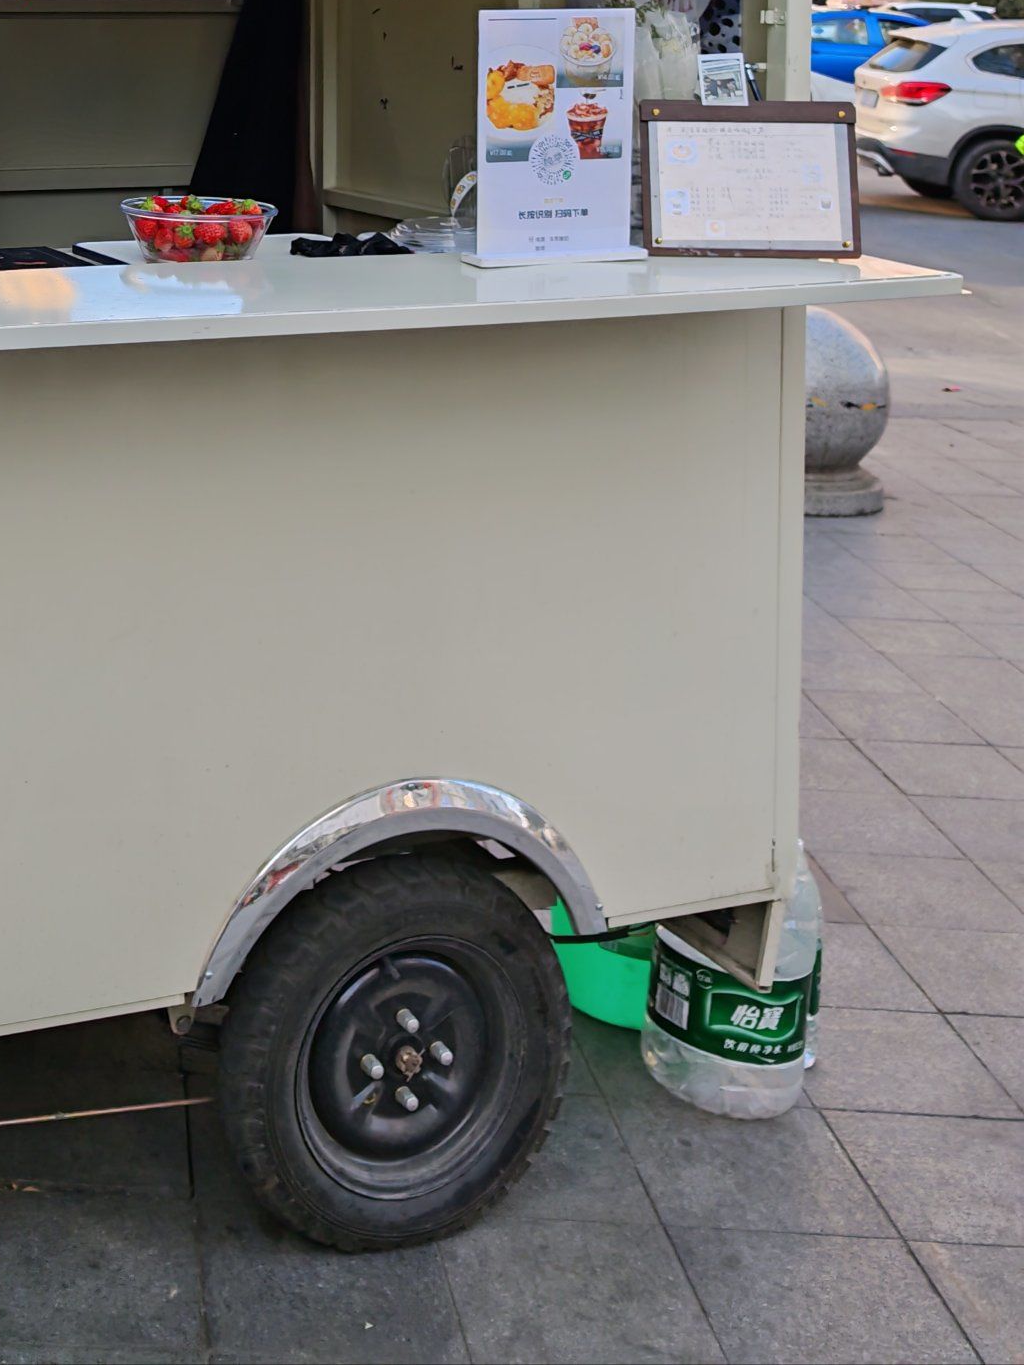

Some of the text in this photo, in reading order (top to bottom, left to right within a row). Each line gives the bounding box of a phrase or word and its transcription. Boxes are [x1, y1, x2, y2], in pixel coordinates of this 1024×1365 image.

[518, 207, 589, 220] 长按识别 扫码下单
[730, 1004, 784, 1031] 怡寶
